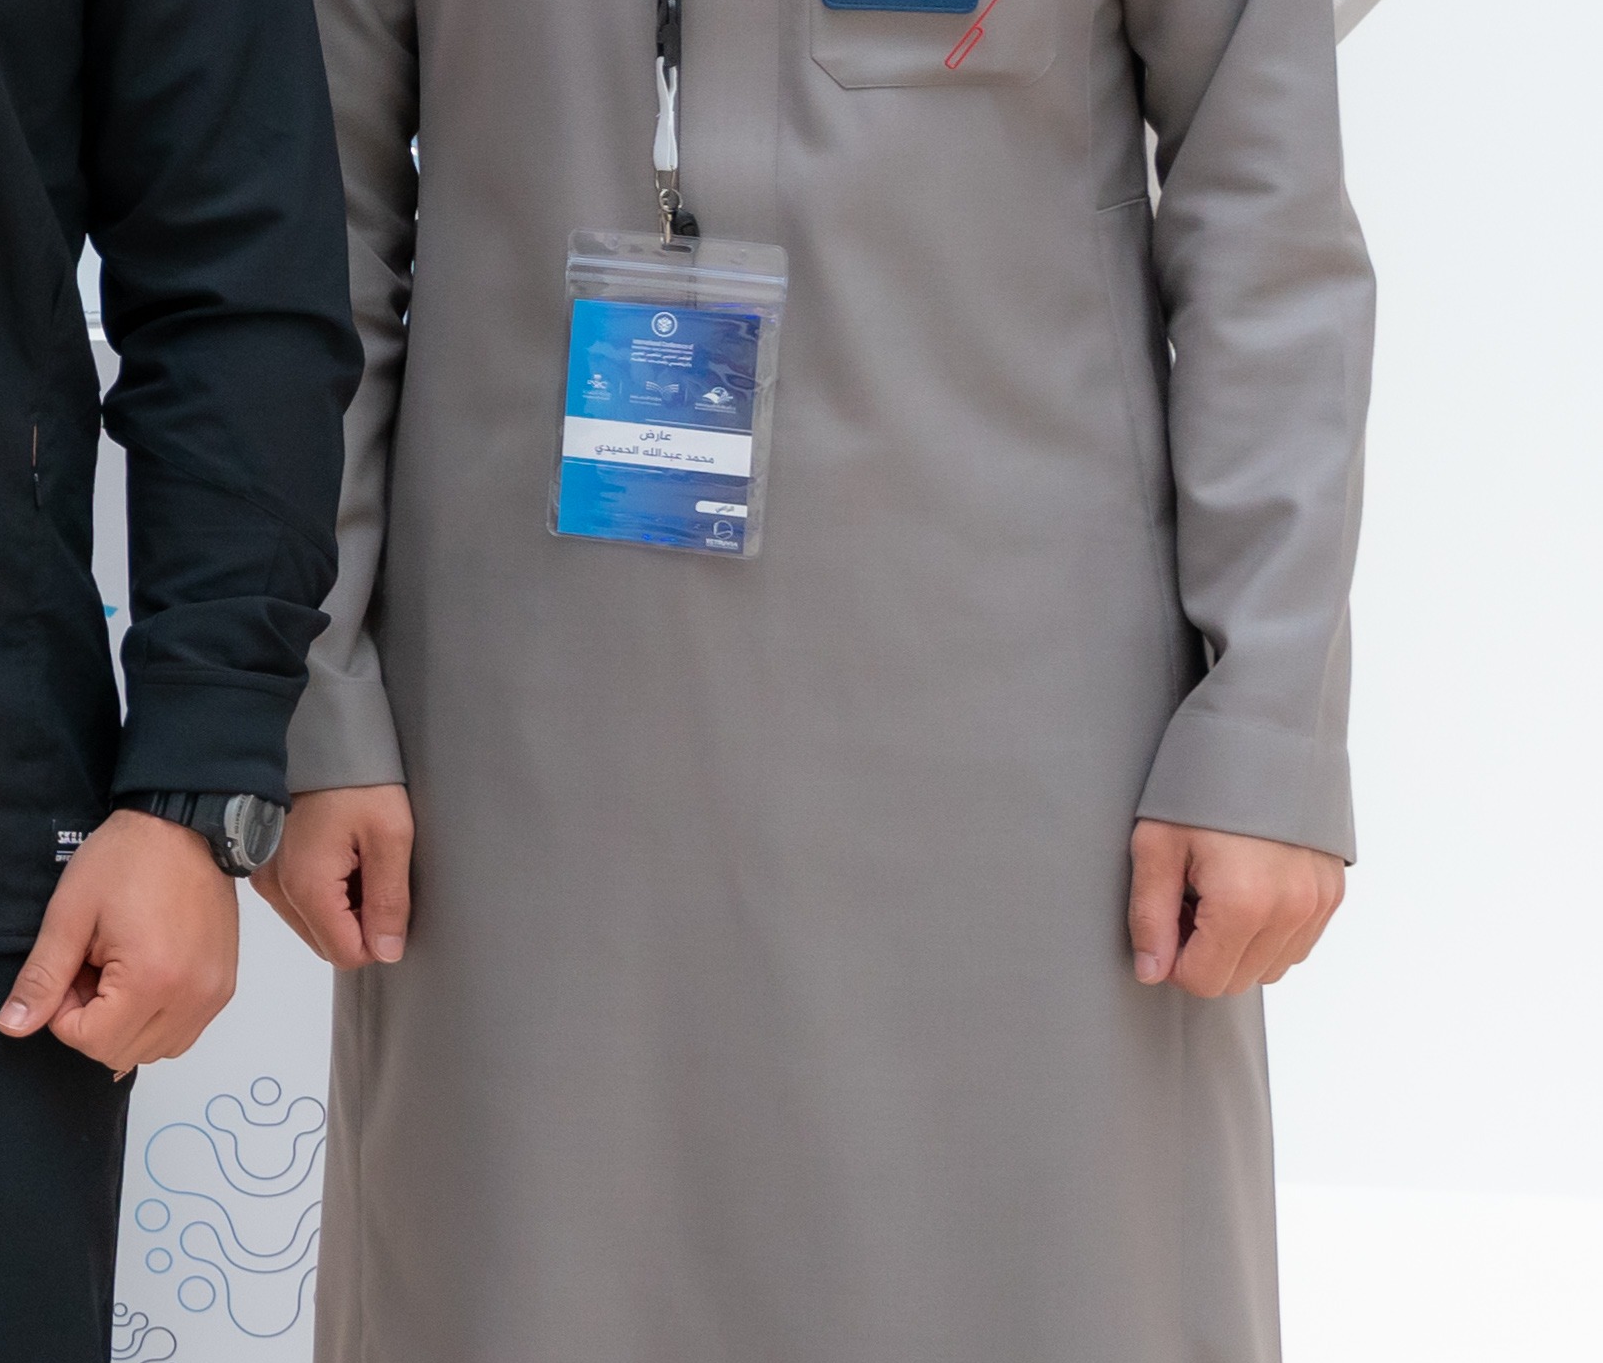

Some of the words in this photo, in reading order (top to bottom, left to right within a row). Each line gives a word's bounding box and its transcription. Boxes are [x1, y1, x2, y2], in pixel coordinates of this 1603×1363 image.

[639, 430, 672, 442] عارض
[594, 444, 639, 456] الحميدي
[642, 447, 682, 461] عبدالله
[685, 453, 715, 464] محمد
[57, 830, 92, 844] SKILL
